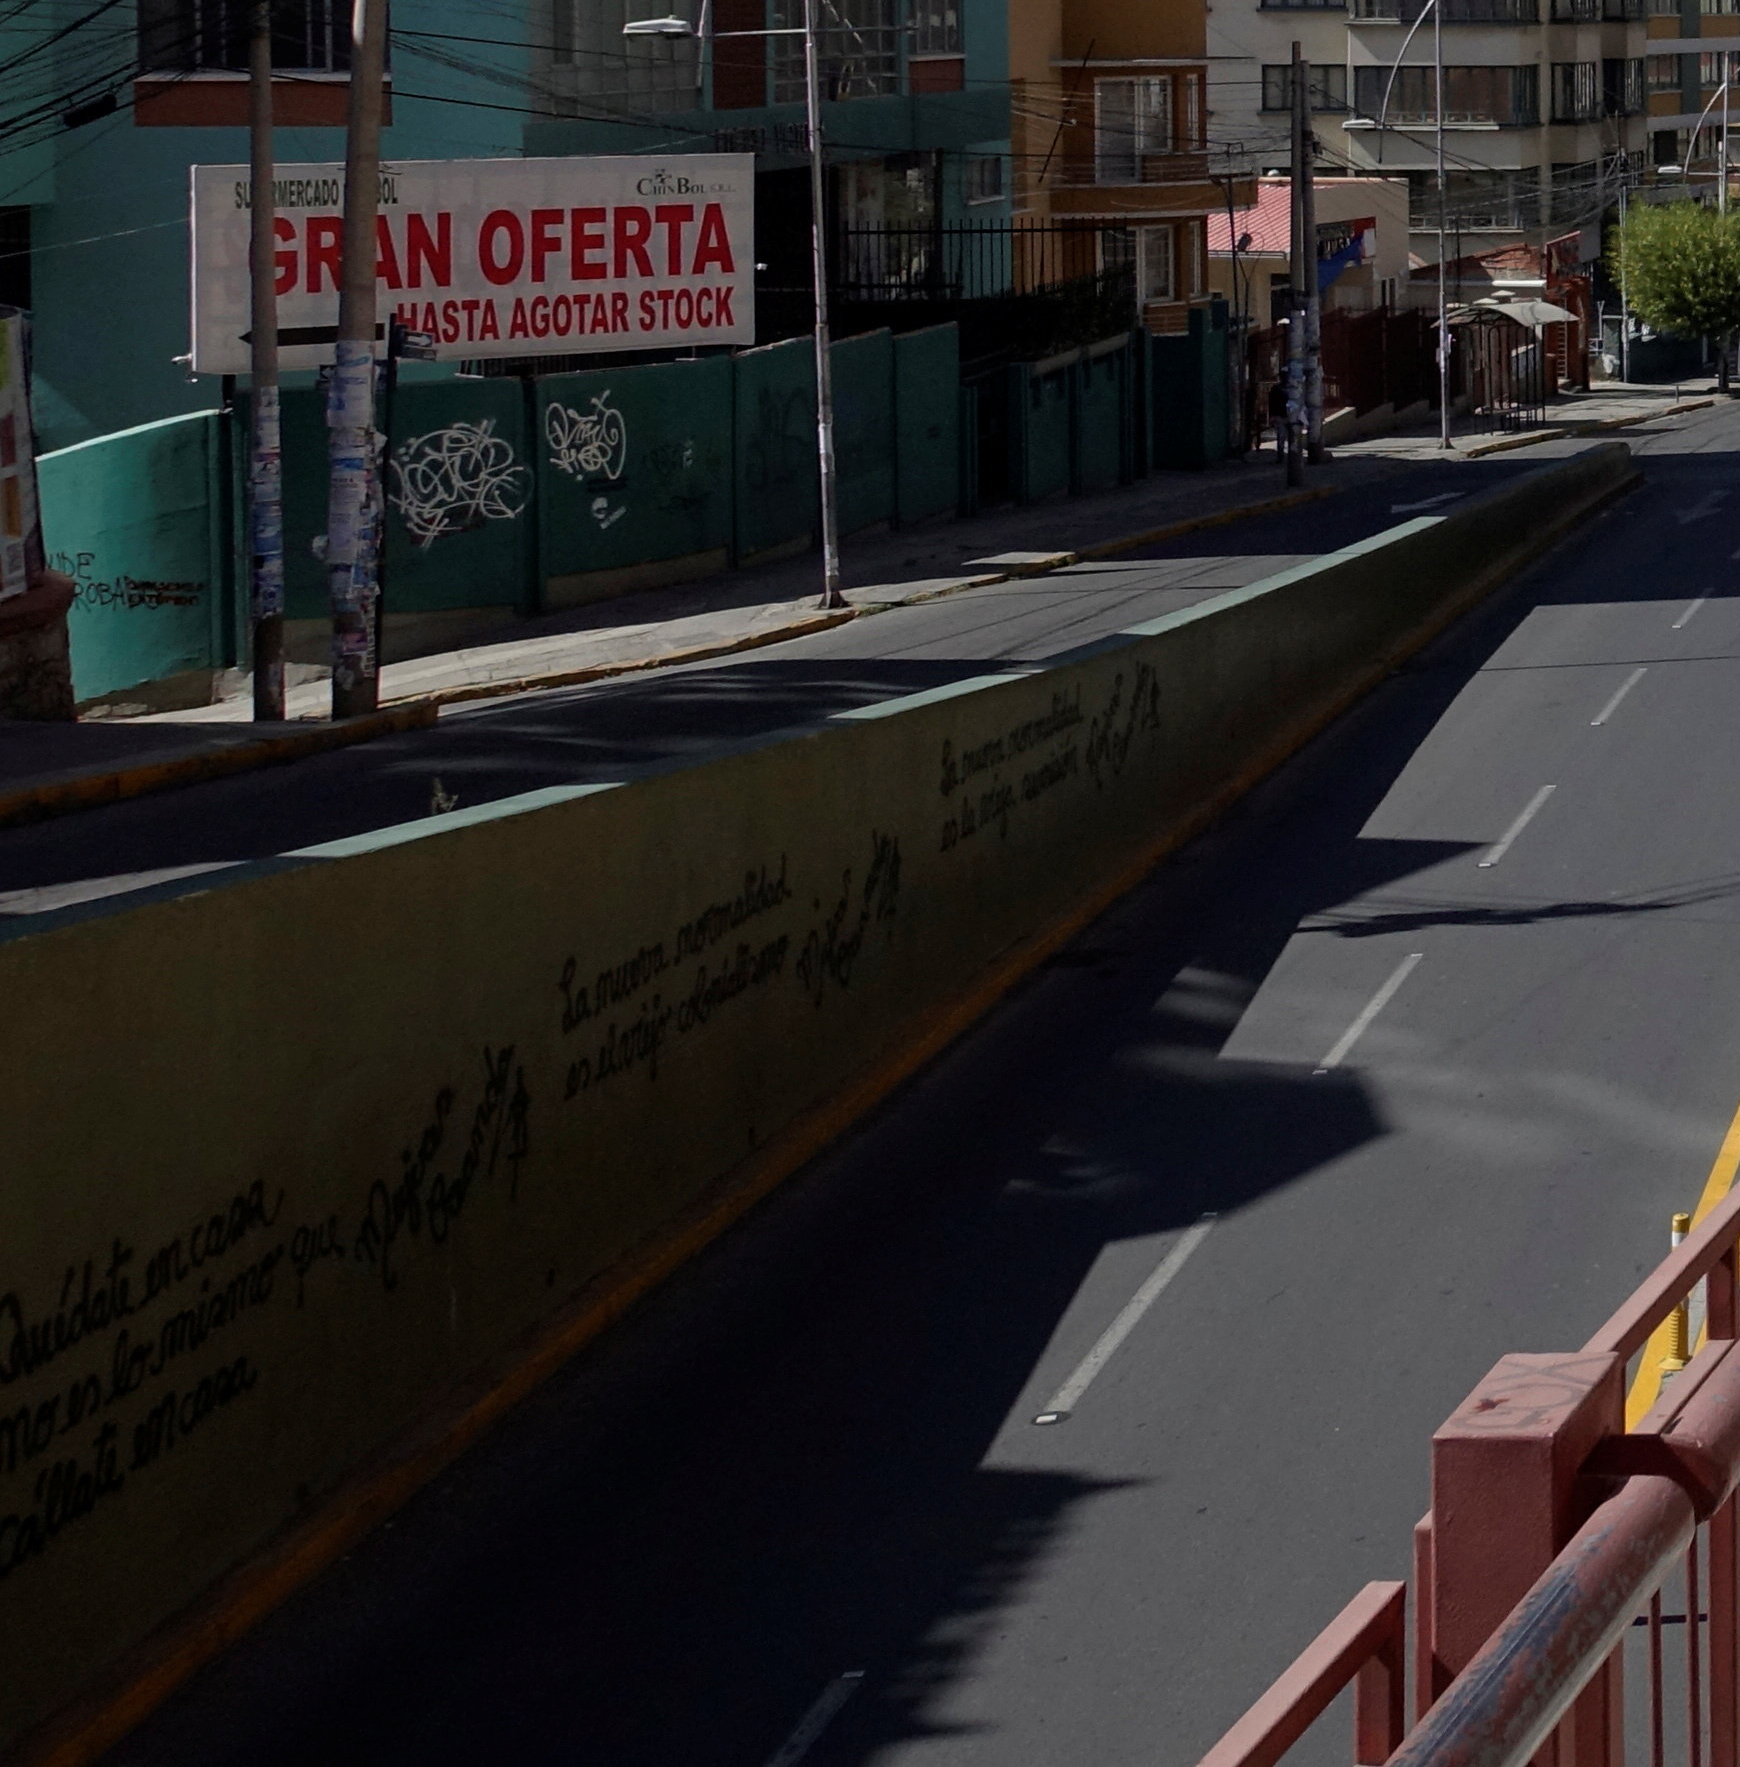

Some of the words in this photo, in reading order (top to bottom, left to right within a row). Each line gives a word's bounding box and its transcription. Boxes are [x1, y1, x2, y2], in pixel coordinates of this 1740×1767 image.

[235, 179, 339, 209] SURMERCADO
[478, 203, 735, 285] OFERTA
[397, 299, 500, 344] HASTA
[508, 292, 629, 339] AGOTAR
[638, 286, 735, 332] STOCK
[291, 1215, 346, 1310] que
